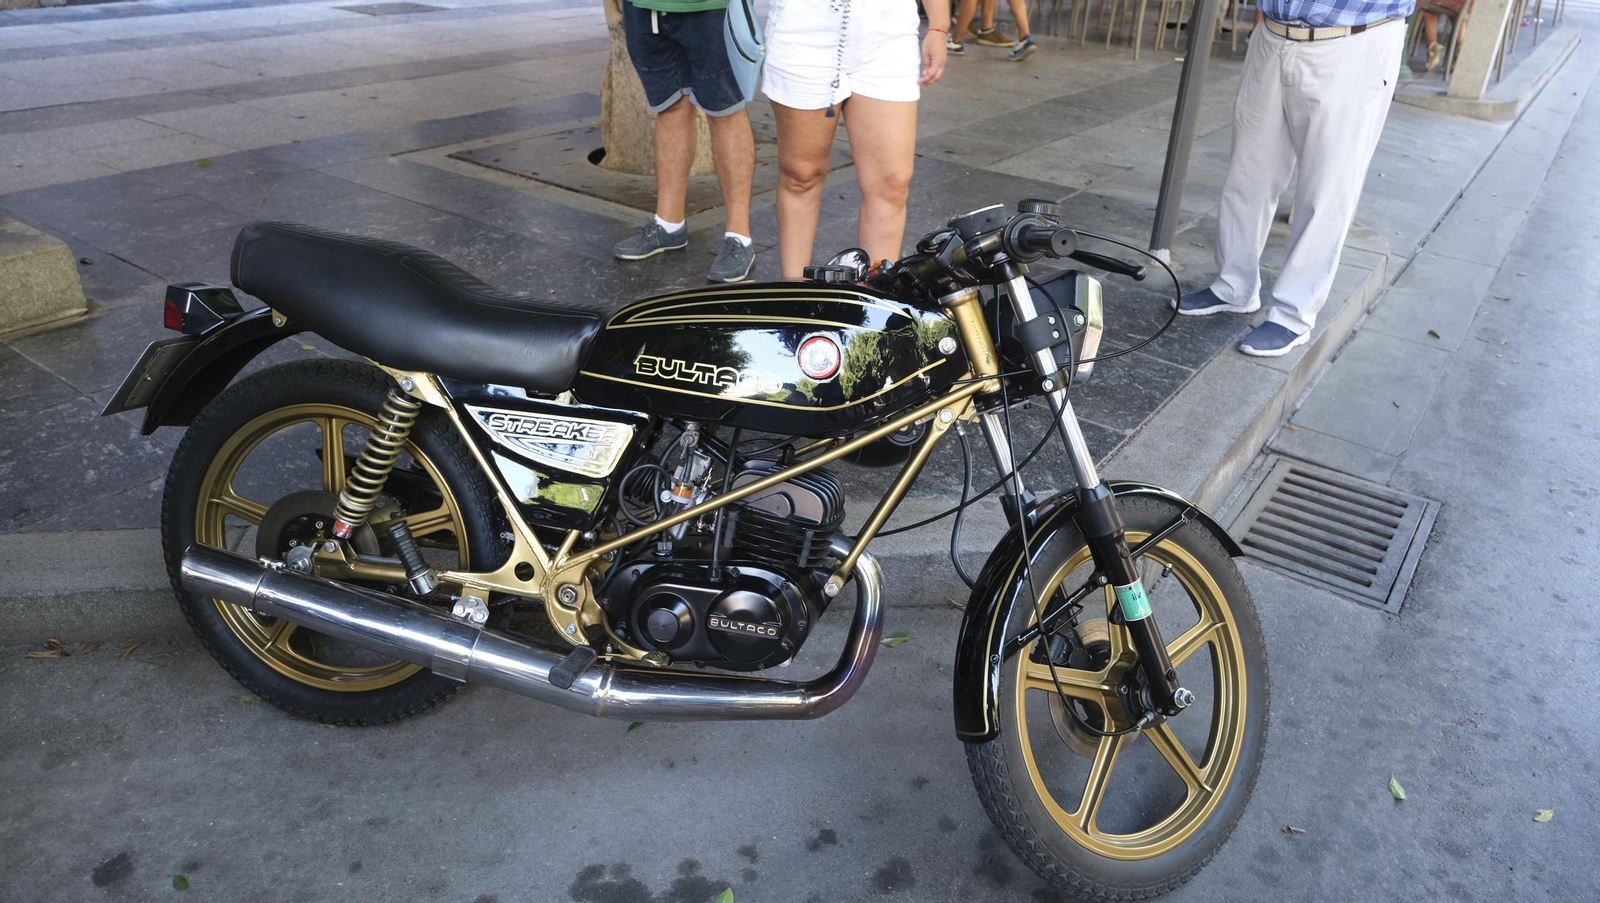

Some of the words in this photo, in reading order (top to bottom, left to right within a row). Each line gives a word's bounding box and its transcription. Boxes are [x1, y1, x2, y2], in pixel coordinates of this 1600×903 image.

[633, 354, 783, 393] BULTACO
[489, 413, 620, 441] STREAKER
[710, 618, 777, 636] BULTACO
